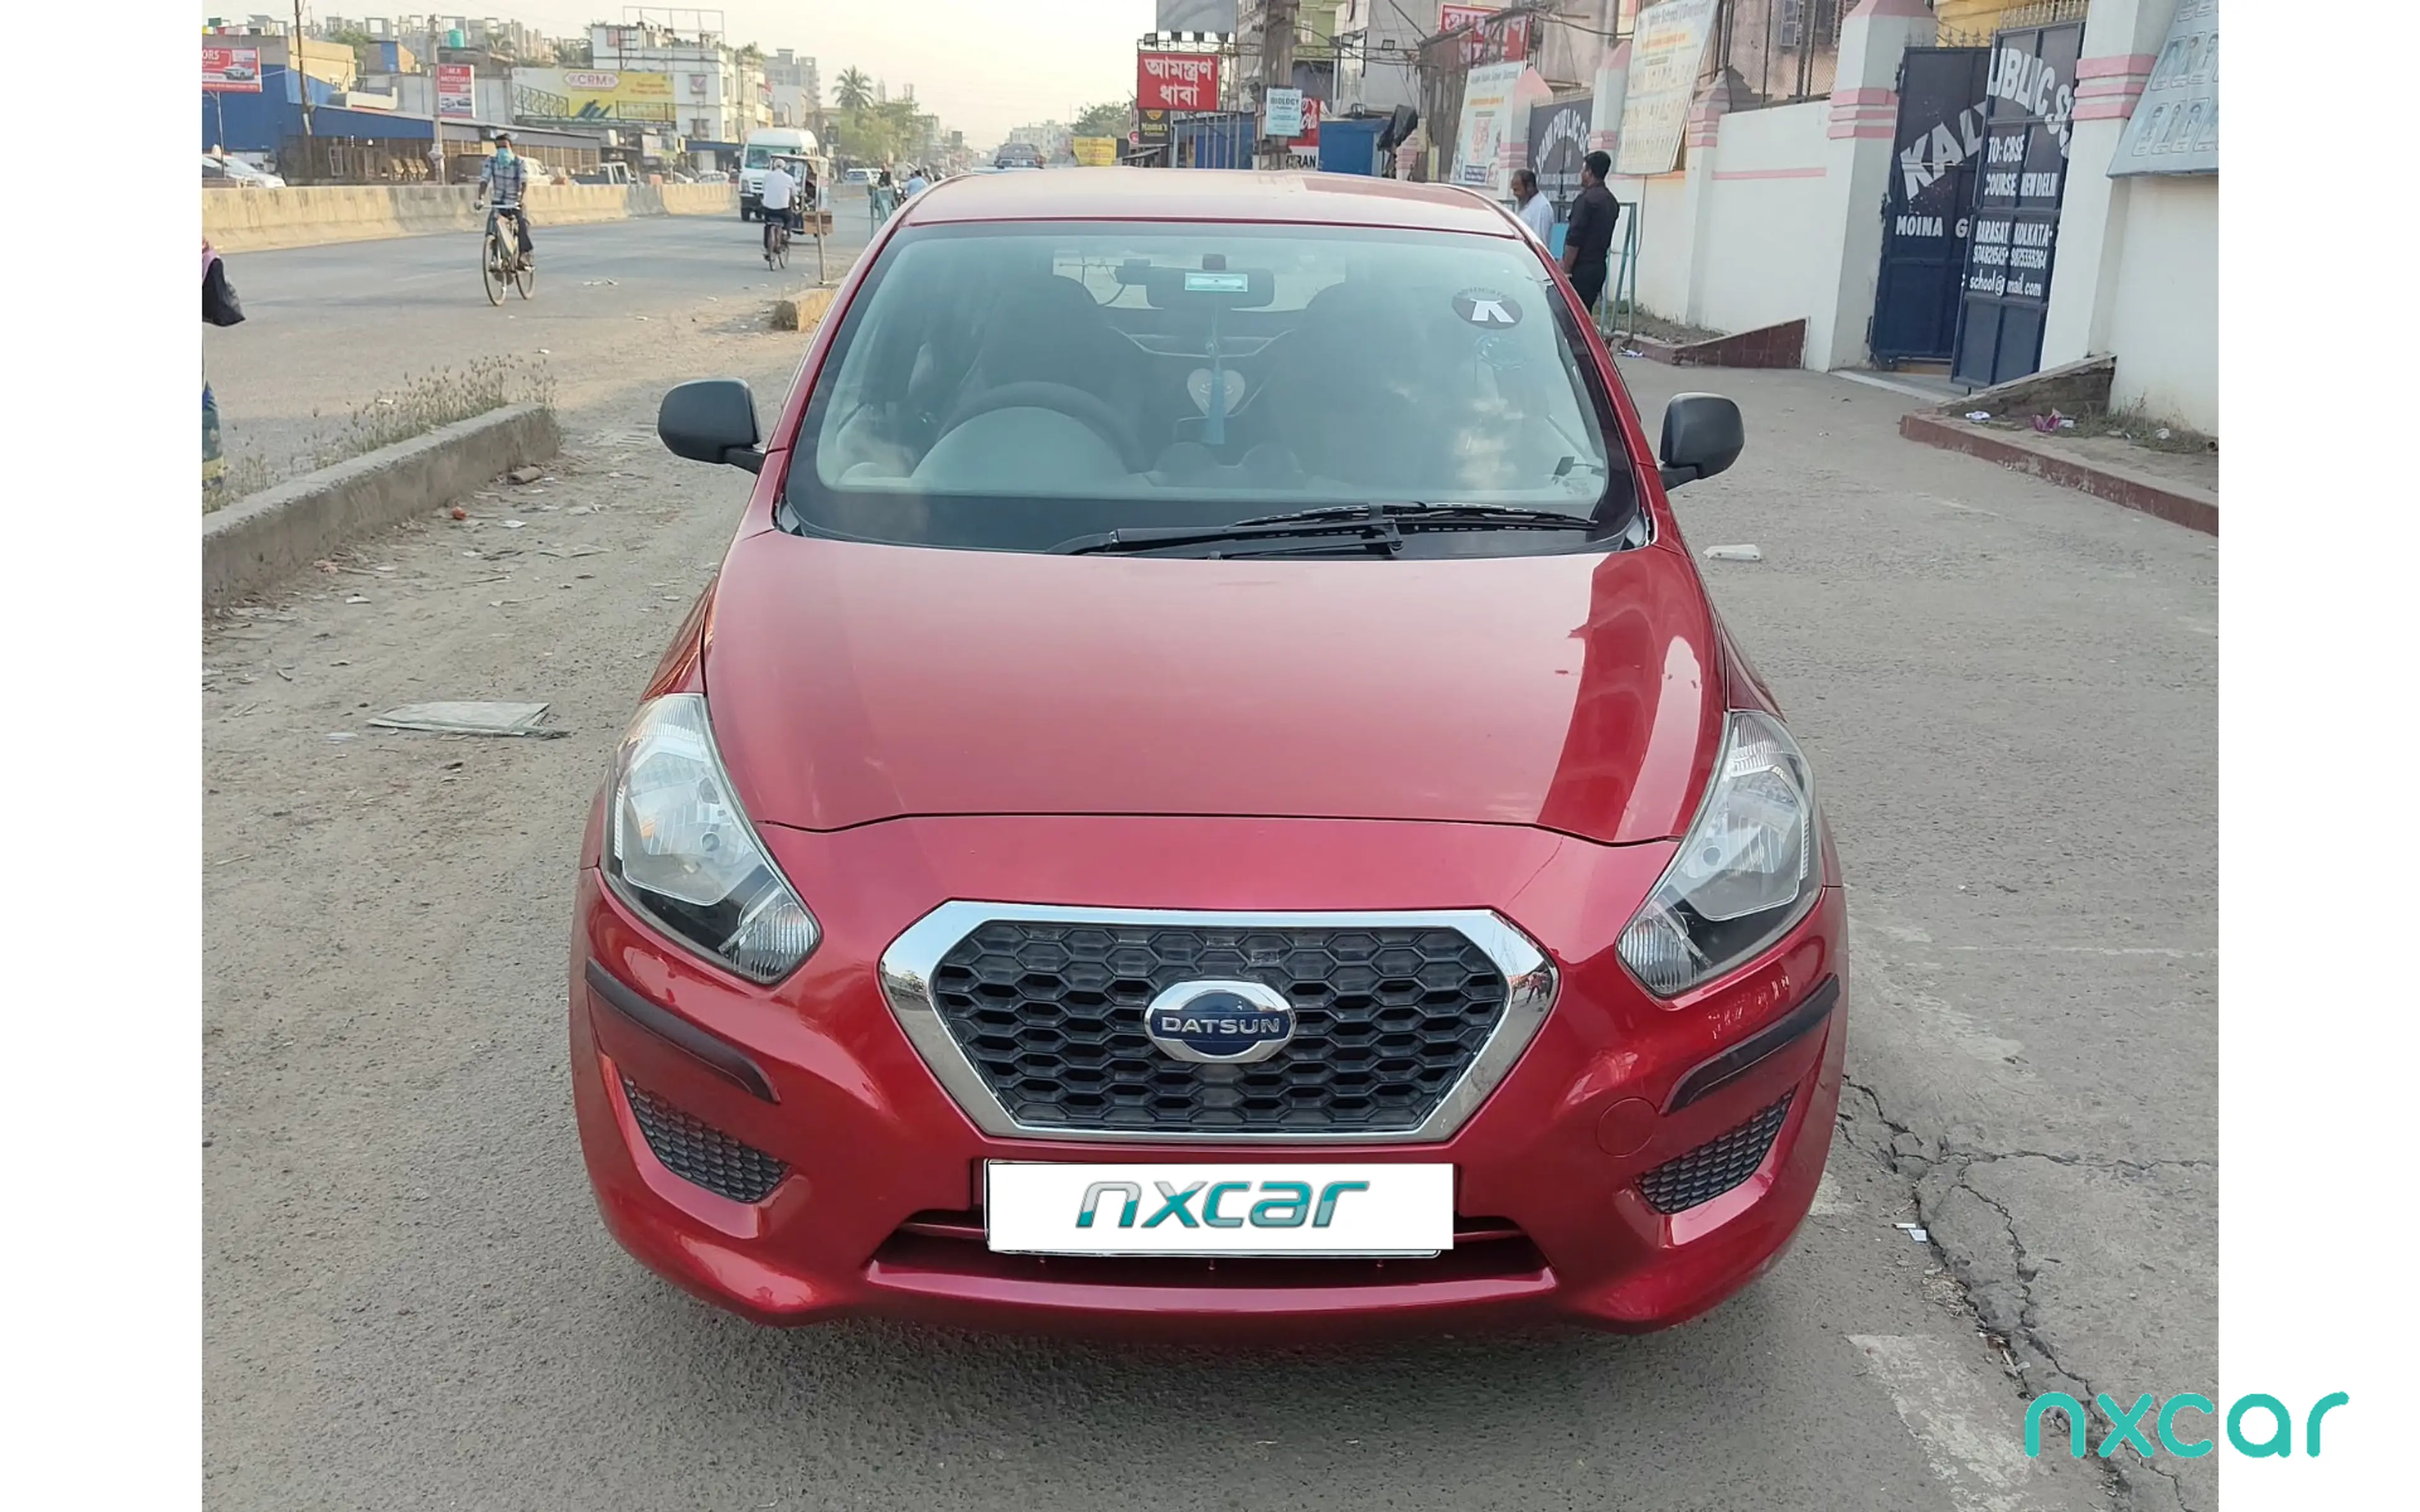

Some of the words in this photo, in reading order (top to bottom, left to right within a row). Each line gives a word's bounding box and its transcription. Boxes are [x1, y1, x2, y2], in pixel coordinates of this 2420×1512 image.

[1143, 55, 1213, 84] আমন্ত্রণ
[1160, 81, 1200, 106] ধাবা
[1270, 96, 1299, 106] BIOLOGY
[1896, 215, 1944, 236] MOINA
[1161, 1016, 1280, 1034] DATSUN
